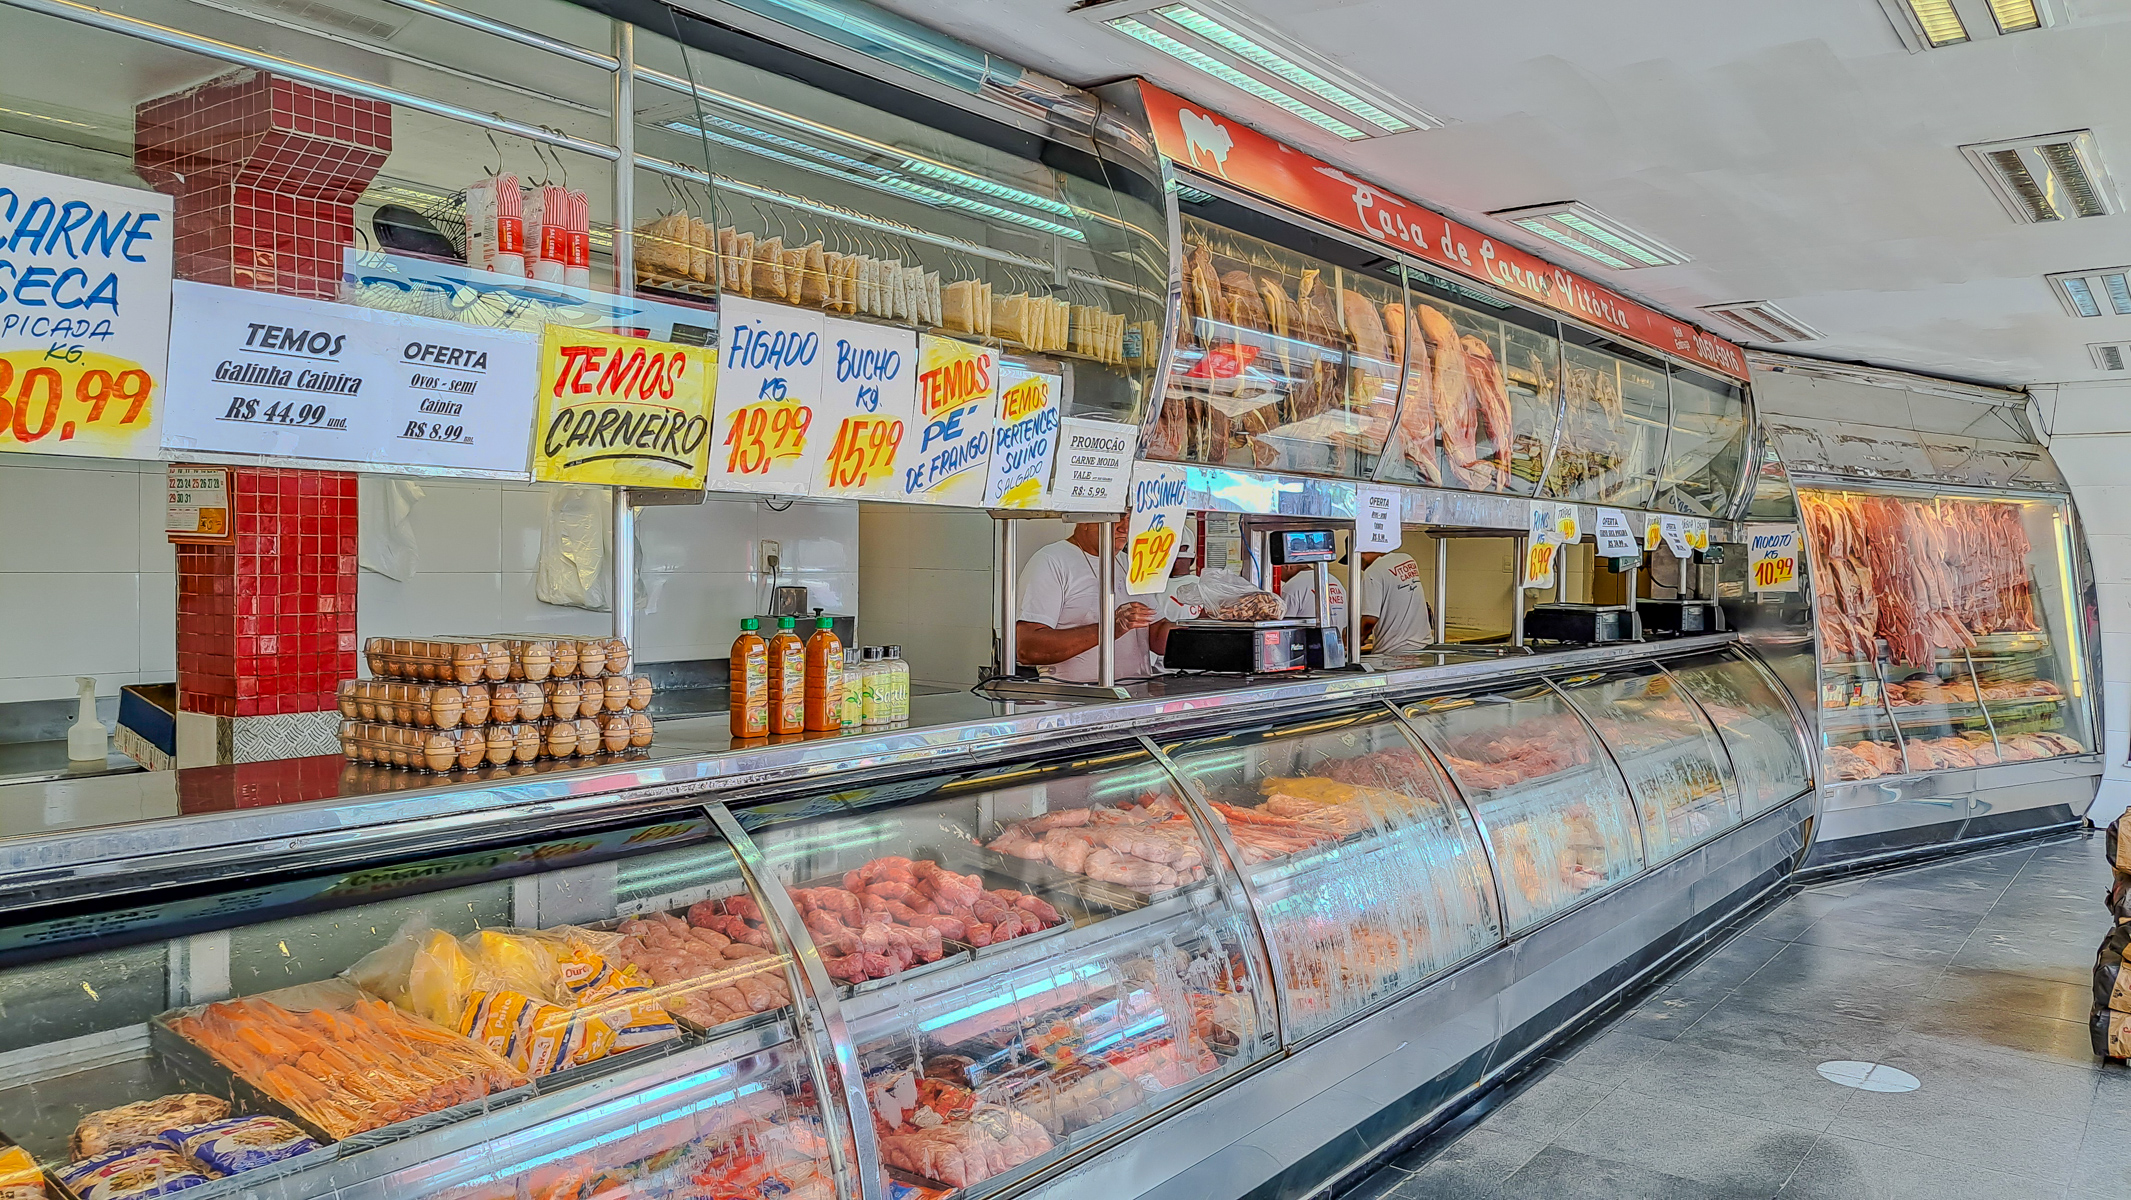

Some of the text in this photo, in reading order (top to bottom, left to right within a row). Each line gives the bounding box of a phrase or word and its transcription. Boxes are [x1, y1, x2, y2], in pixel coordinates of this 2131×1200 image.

[1352, 183, 1428, 250] Casa
[1441, 222, 1472, 266] de
[1555, 270, 1630, 330] Vitória
[2, 314, 115, 342] PICADA
[246, 323, 347, 356] TEMOS
[403, 342, 488, 370] OFERTA
[553, 346, 686, 400] TEMOS
[836, 339, 901, 383] BUCHO
[215, 360, 363, 395] Galinha Caipira
[411, 373, 440, 389] Ovos
[449, 380, 478, 393] semi
[919, 353, 991, 416] TEMOS
[225, 396, 260, 420] R$
[420, 398, 463, 415] Caipira
[1002, 383, 1049, 420] TEMOS
[403, 421, 427, 438] R$
[545, 408, 708, 458] CARNEIRO
[996, 406, 1058, 455] PERTENCES
[905, 430, 988, 495] DE FRANGO
[1071, 455, 1119, 467] CARNE MOIDA
[1073, 471, 1092, 480] VALE
[995, 461, 1043, 499] SALGADO
[1369, 496, 1389, 508] OFERTA
